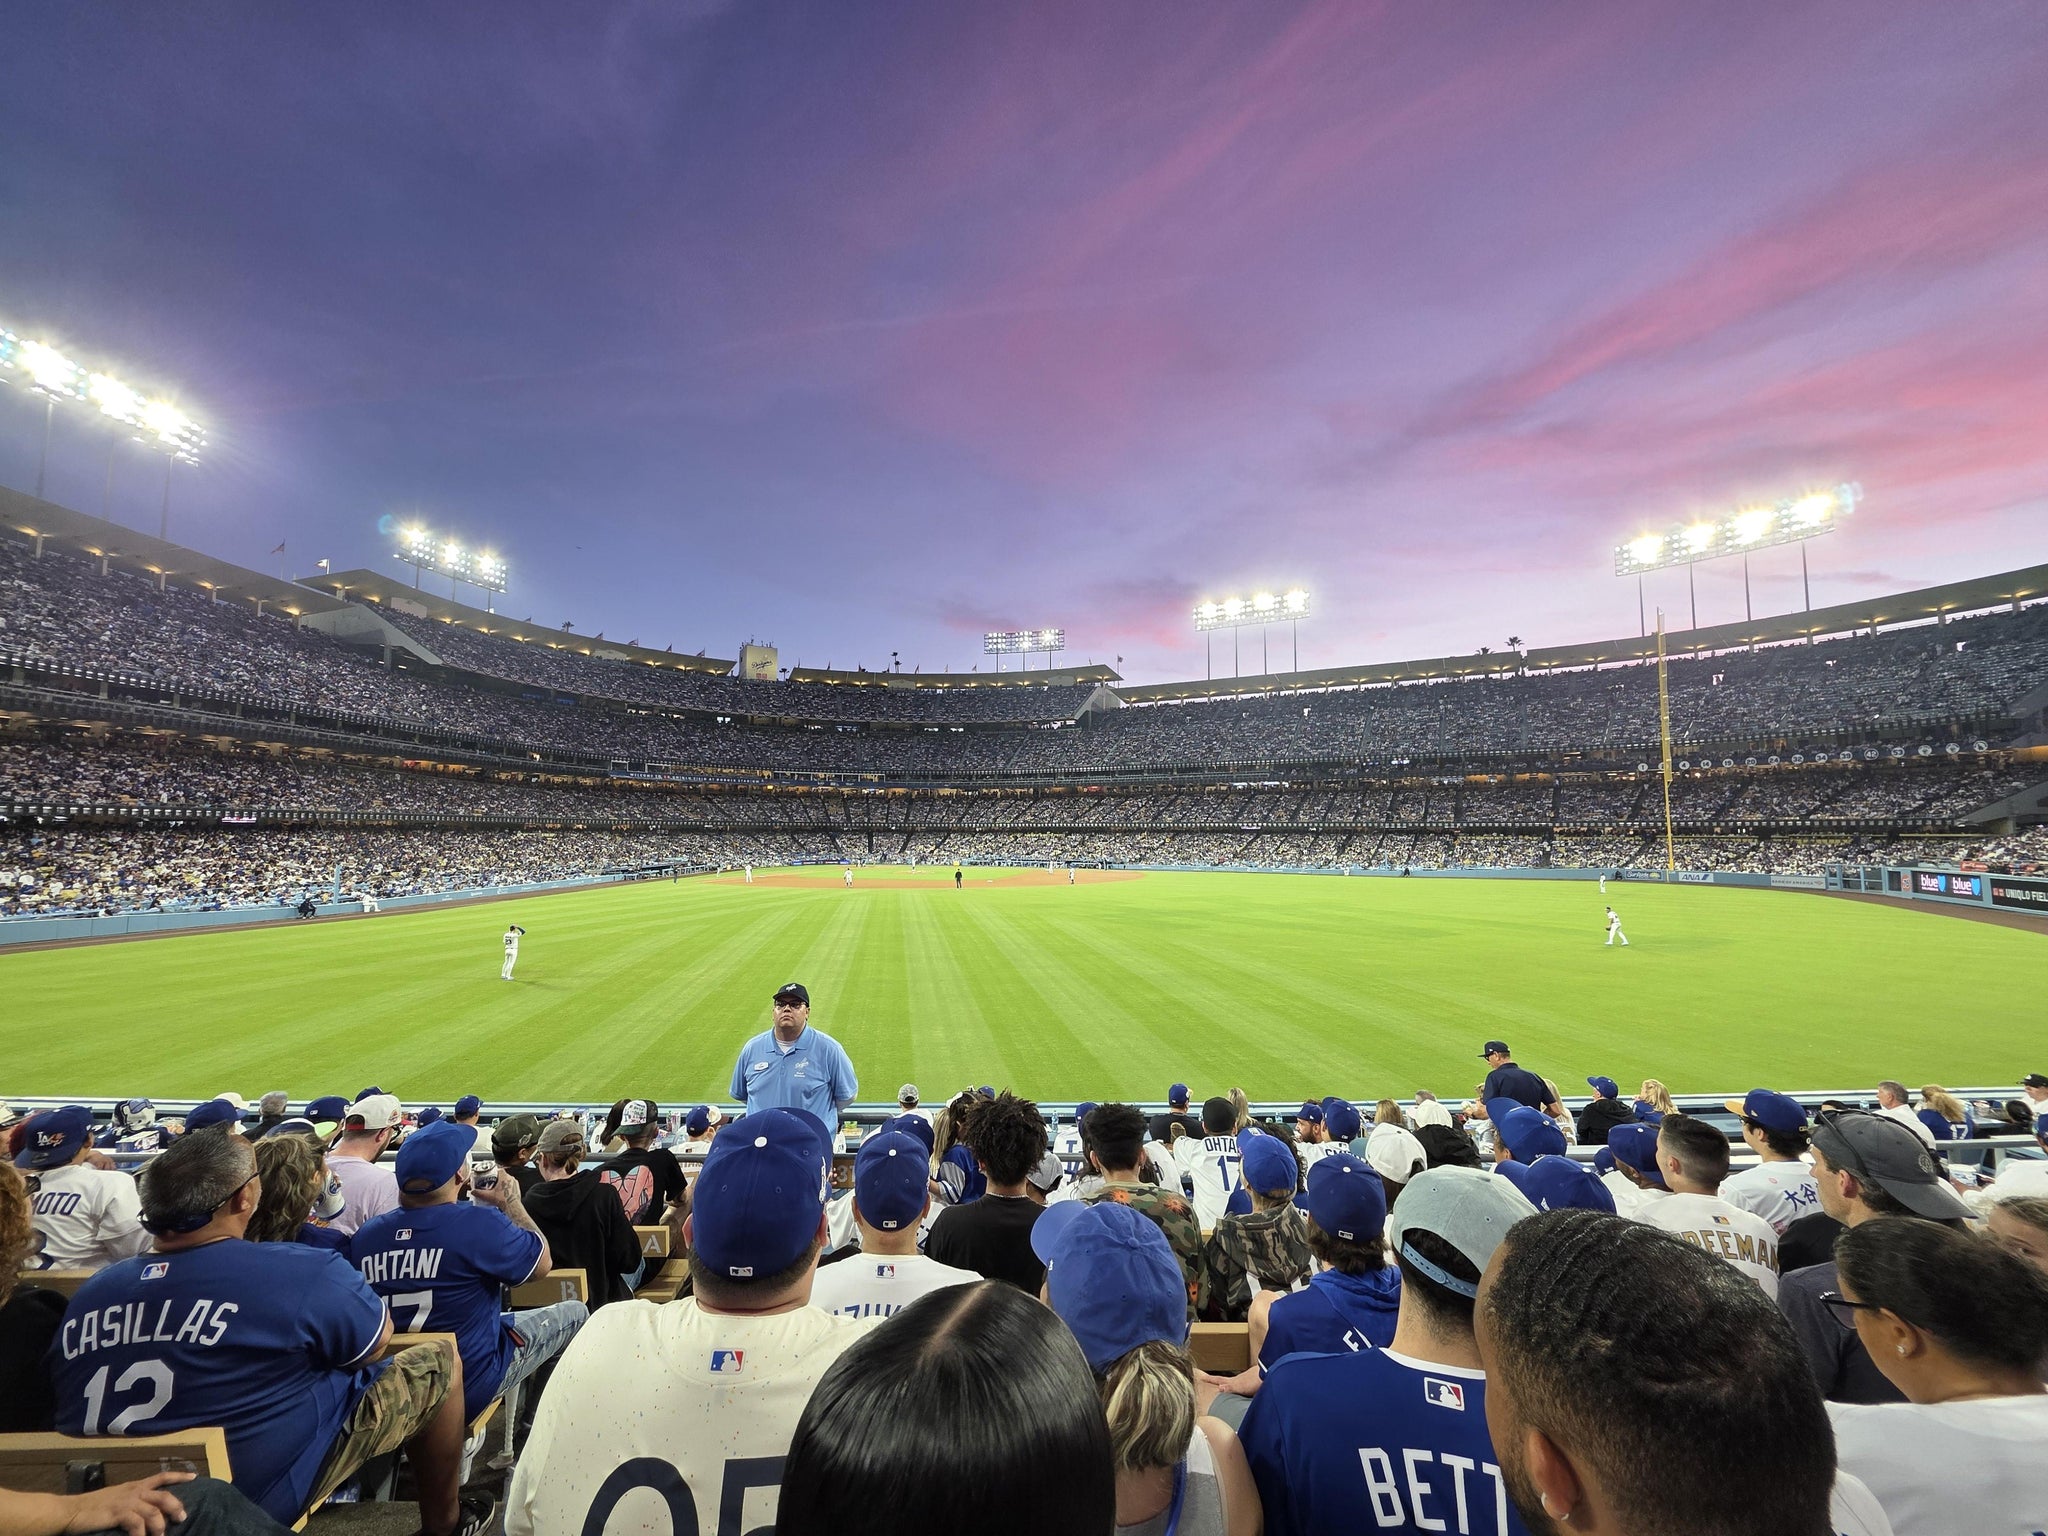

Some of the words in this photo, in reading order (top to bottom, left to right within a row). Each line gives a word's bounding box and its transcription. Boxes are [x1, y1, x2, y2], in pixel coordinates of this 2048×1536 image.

[1682, 873, 1700, 881] ANA
[1921, 874, 1938, 887] blue
[1953, 877, 1972, 891] blue
[2005, 888, 2031, 901] UNIQLO
[1949, 1124, 1969, 1141] 17
[1204, 1137, 1241, 1154] OHTA
[1784, 1182, 1818, 1212] 大谷
[643, 1234, 662, 1253] A
[361, 1248, 444, 1284] OHTANI
[560, 1281, 578, 1300] B
[381, 1289, 433, 1333] 7
[62, 1299, 239, 1361] CASILLAS
[83, 1359, 174, 1436] 12
